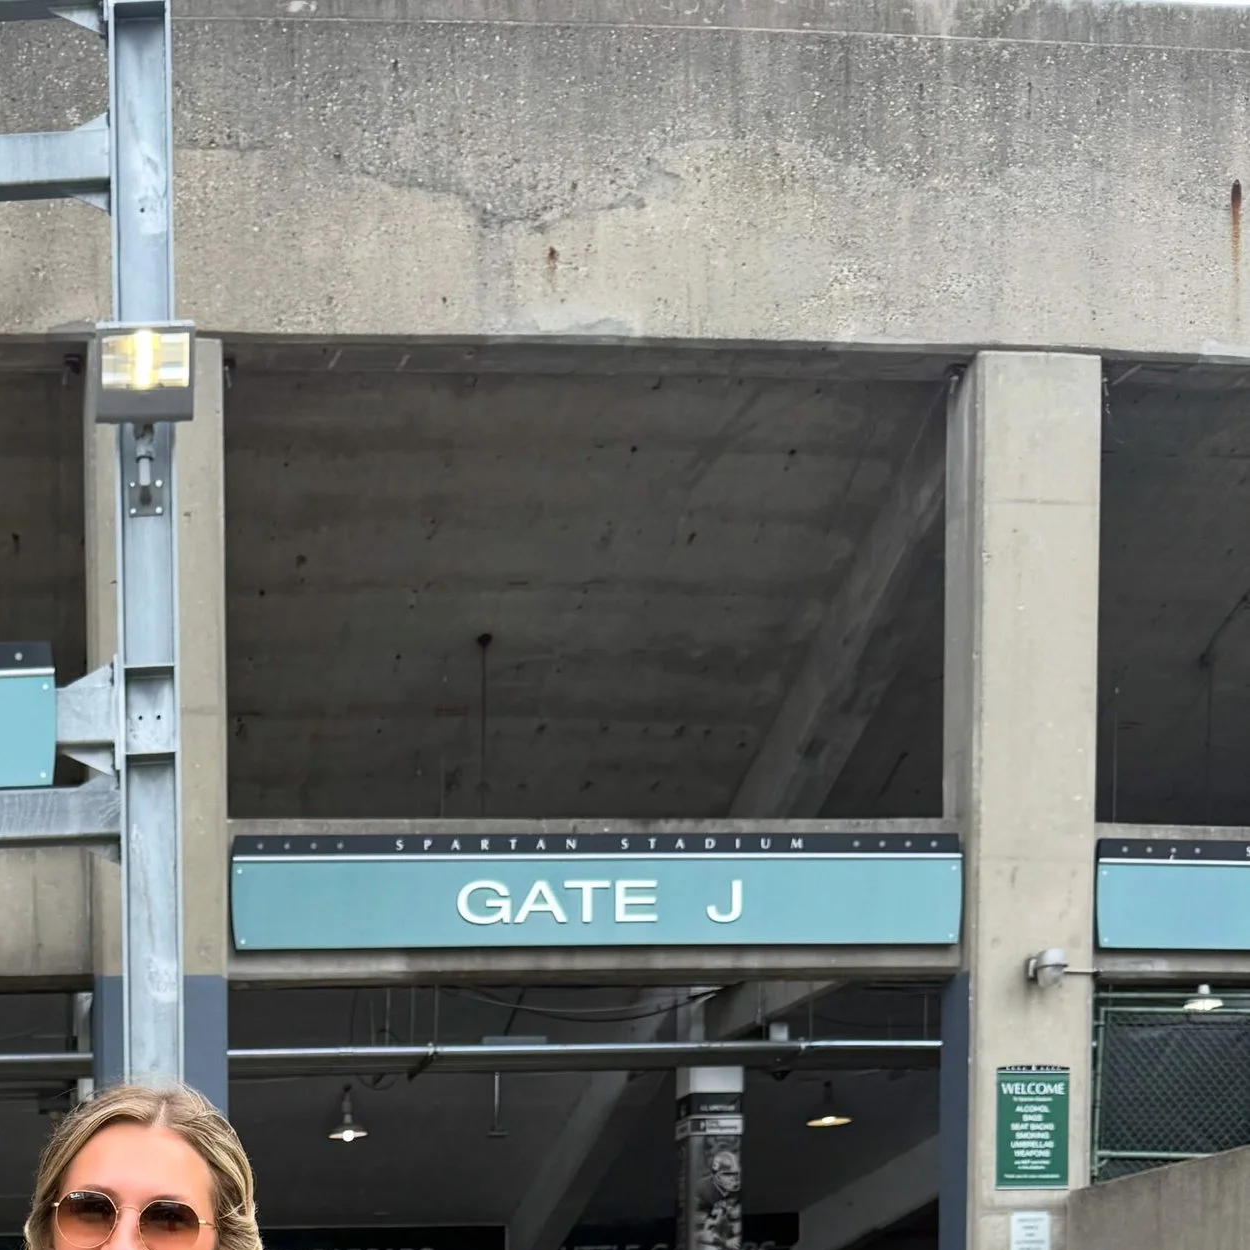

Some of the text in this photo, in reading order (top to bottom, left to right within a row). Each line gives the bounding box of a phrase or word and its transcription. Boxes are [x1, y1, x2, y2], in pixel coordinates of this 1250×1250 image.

[395, 838, 805, 852] SPARTAN STADIUM
[456, 879, 743, 926] GATE J
[1001, 1082, 1066, 1095] WELCOME
